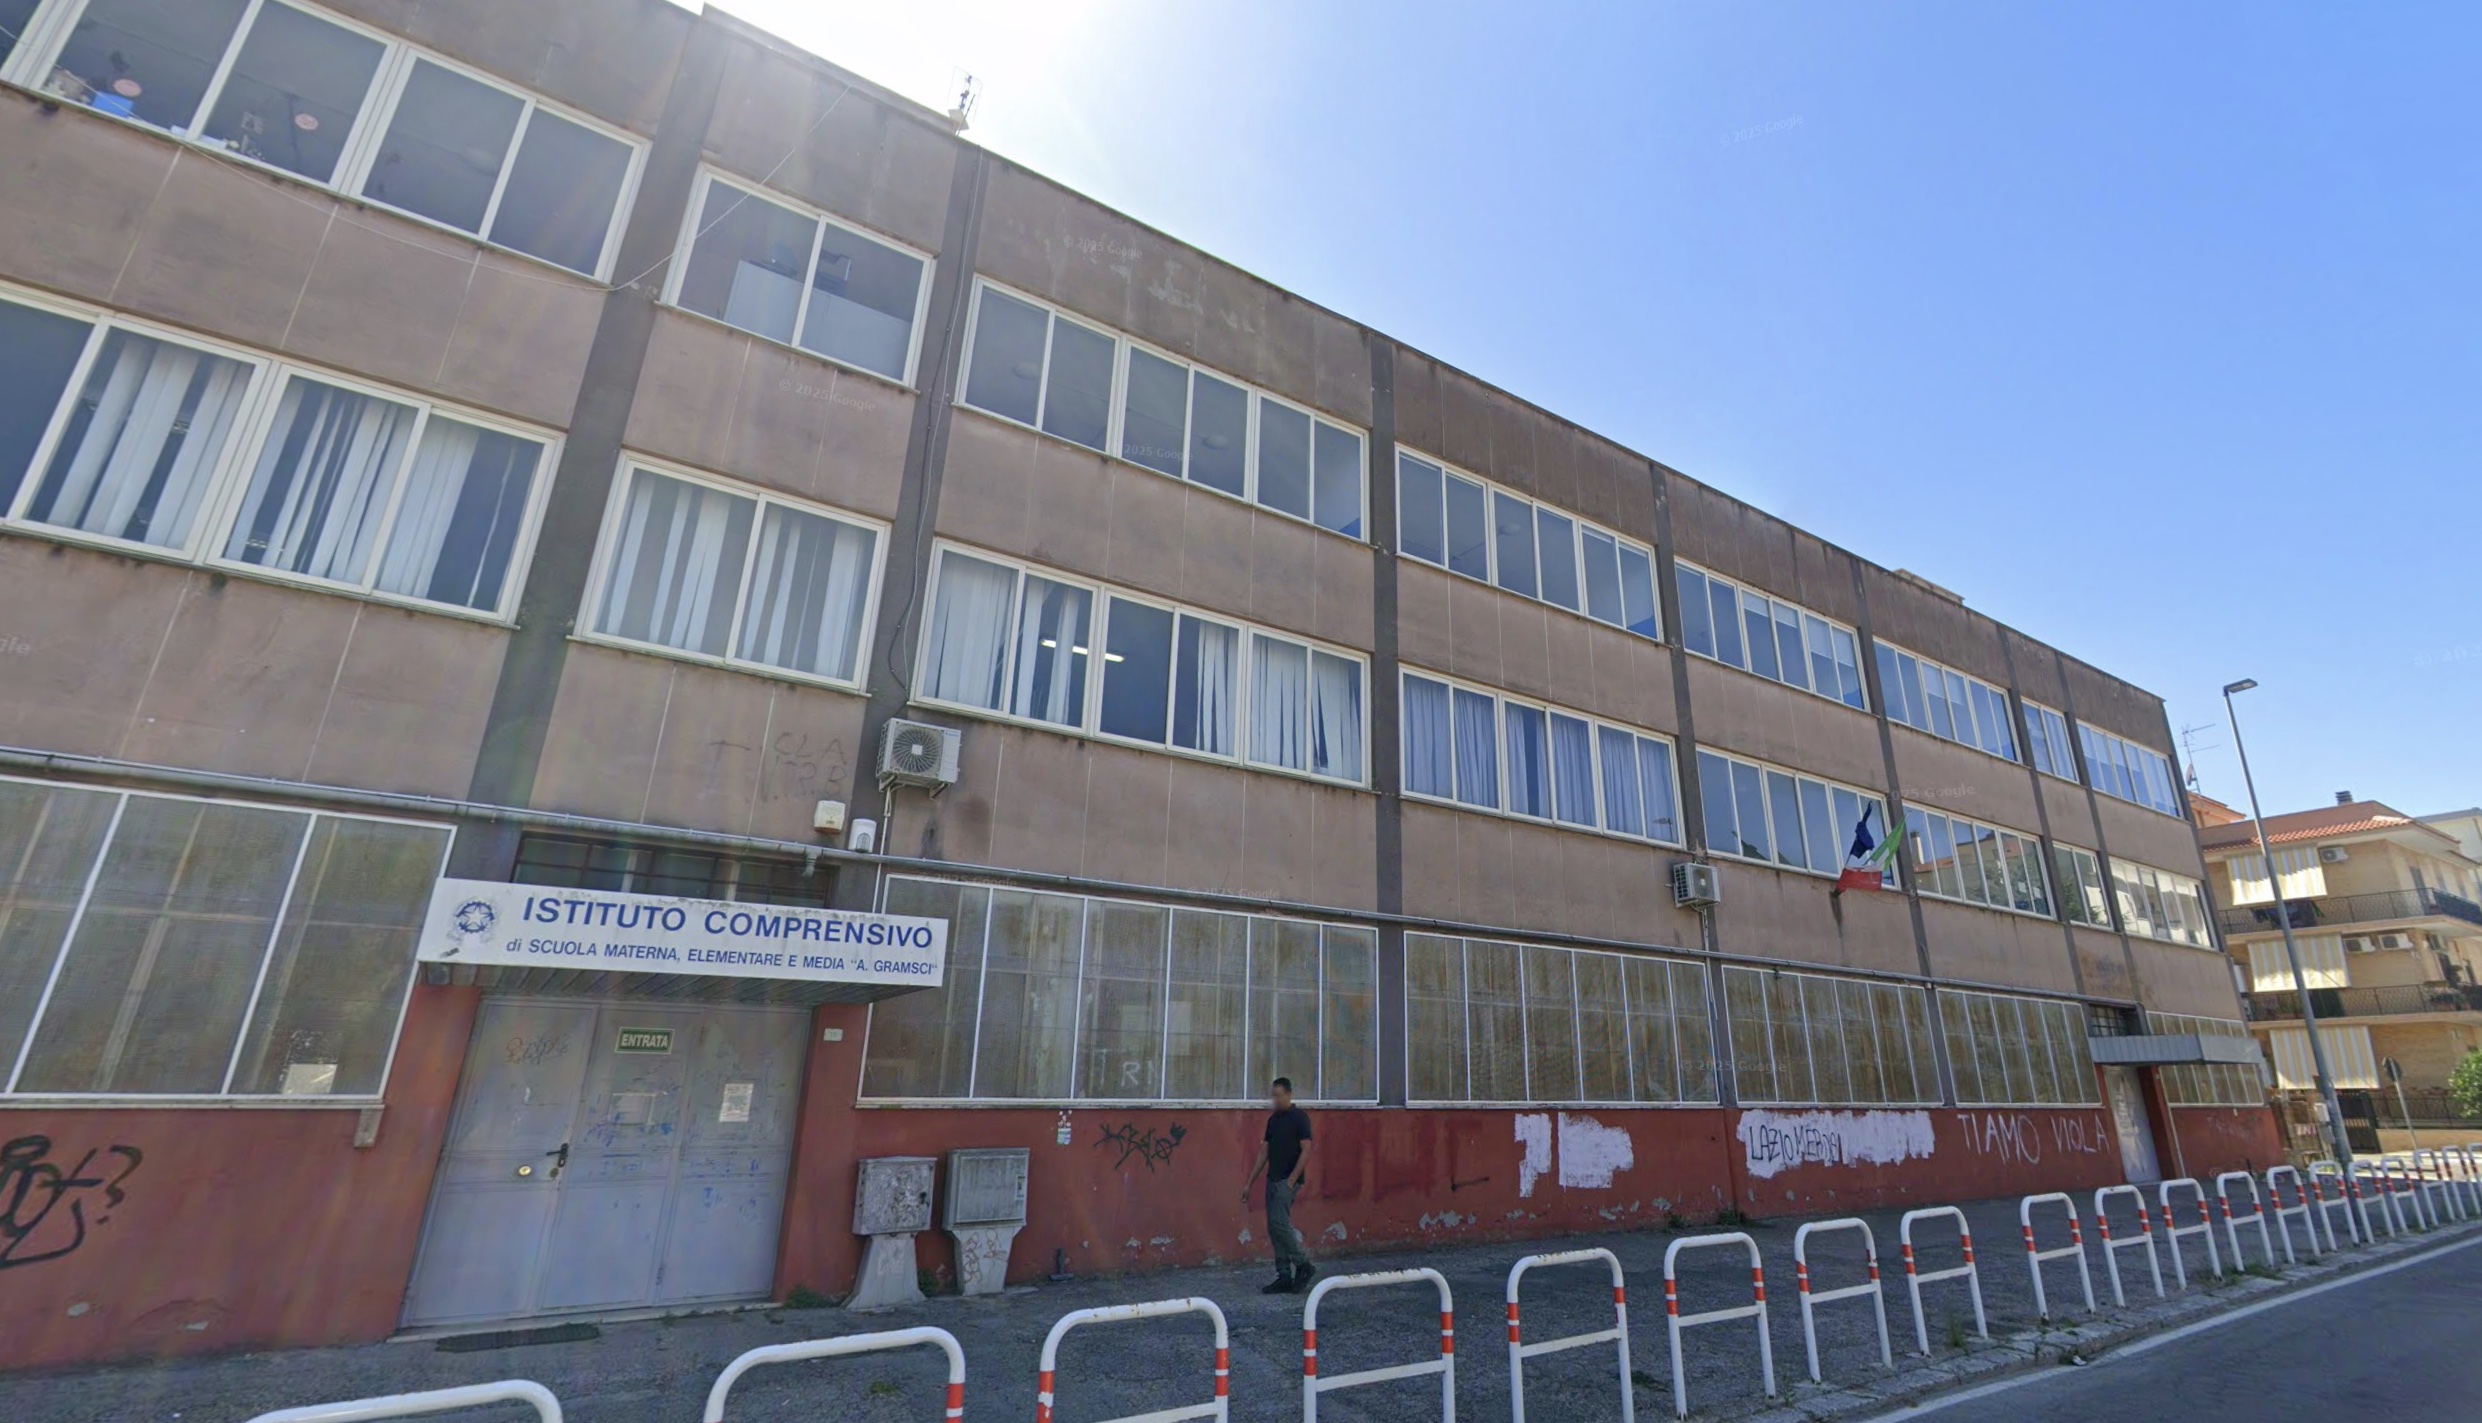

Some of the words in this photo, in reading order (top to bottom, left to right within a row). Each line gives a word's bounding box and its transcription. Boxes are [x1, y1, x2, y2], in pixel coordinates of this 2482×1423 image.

[523, 897, 686, 931] ISTITUTO
[704, 911, 933, 948] COMPRENSIVO
[506, 938, 522, 952] di
[528, 939, 597, 956] SCUOLA
[604, 943, 681, 964] MATERNA,
[688, 948, 783, 967] ELEMENTARE
[788, 954, 798, 967] E
[803, 956, 845, 970] MEDIA
[621, 1033, 668, 1048] ENTRATA
[1748, 1124, 1793, 1164] LAZIO
[2050, 1114, 2111, 1154] VIOLA
